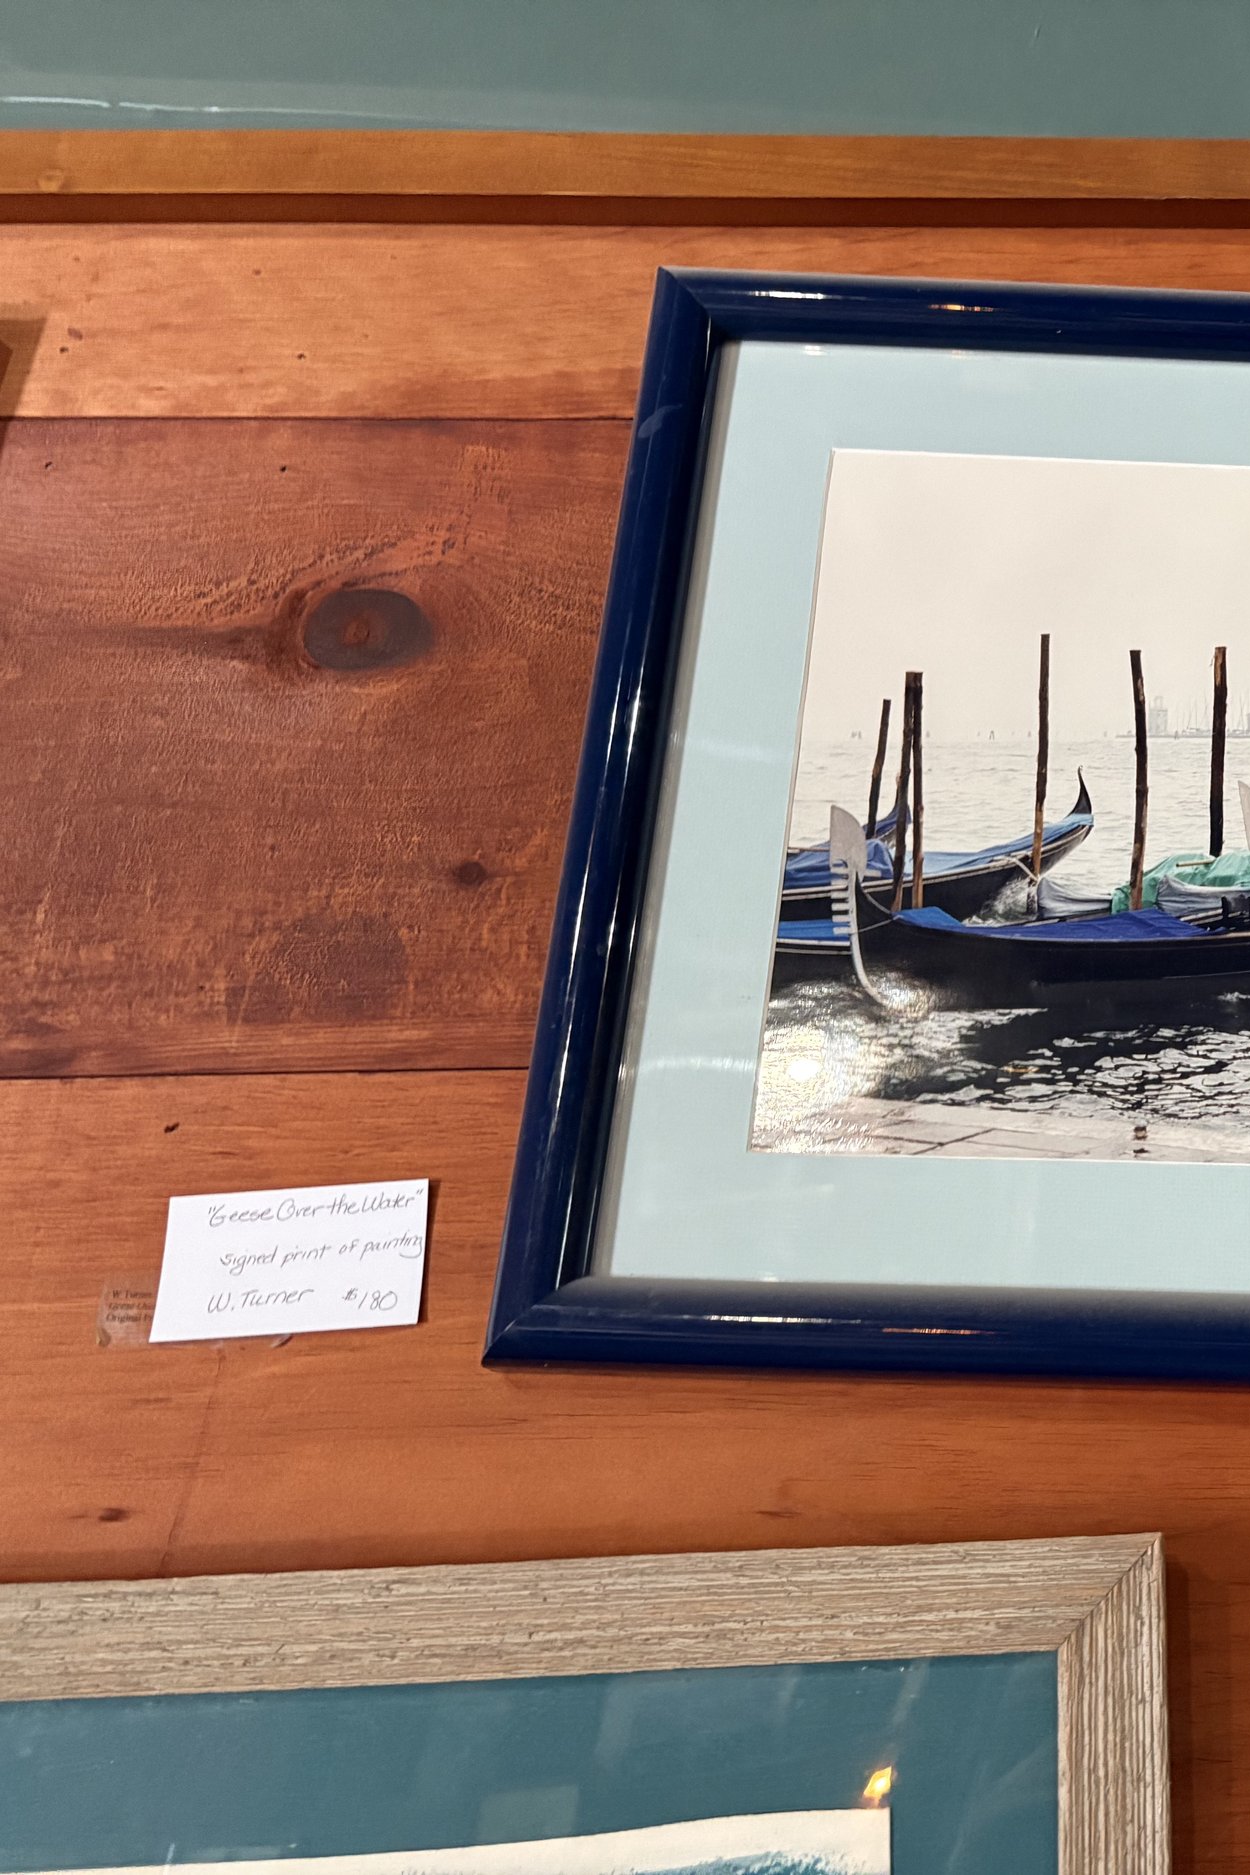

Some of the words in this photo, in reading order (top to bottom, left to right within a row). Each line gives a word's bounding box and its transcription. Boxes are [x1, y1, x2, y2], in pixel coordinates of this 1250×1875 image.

[208, 1203, 274, 1227] "Geese
[277, 1198, 325, 1221] Over
[324, 1193, 360, 1216] the
[219, 1245, 278, 1276] signed
[280, 1244, 332, 1268] print
[338, 1238, 360, 1255] of
[360, 1229, 423, 1261] painting
[207, 1294, 235, 1313] W.
[241, 1288, 315, 1308] Turner
[342, 1287, 398, 1312] $180
